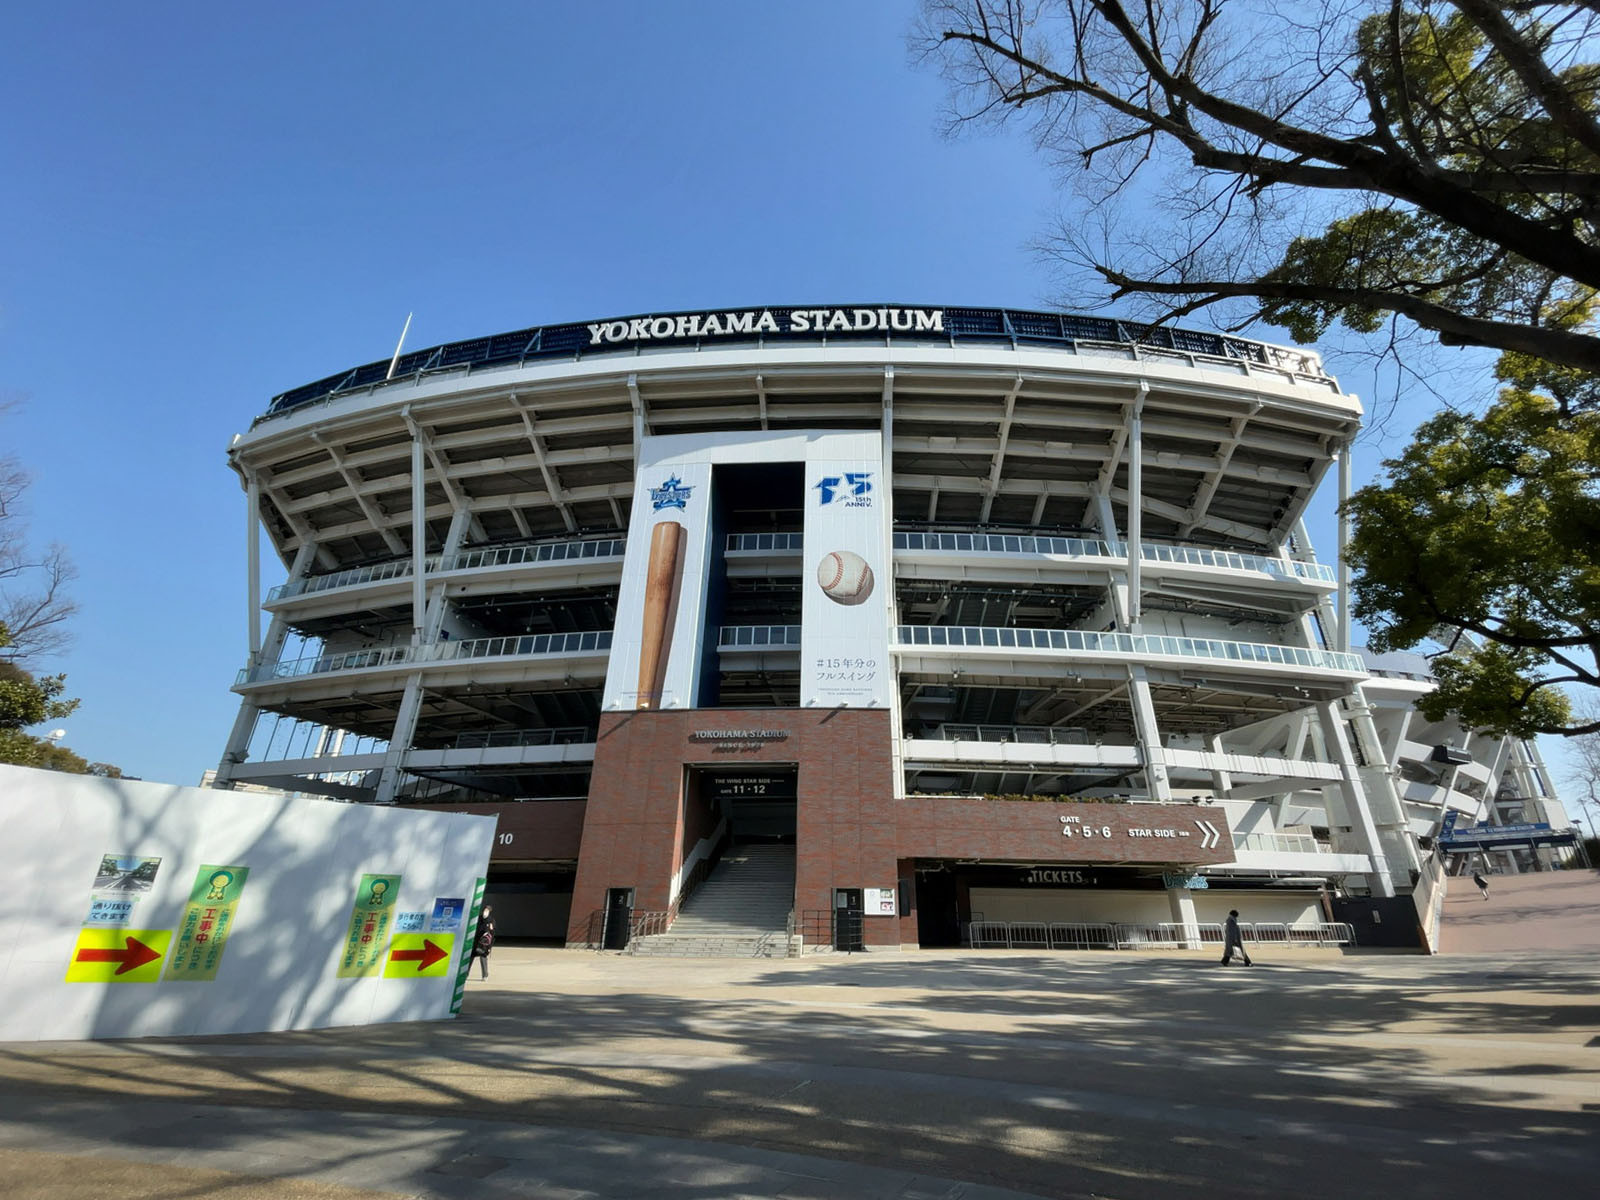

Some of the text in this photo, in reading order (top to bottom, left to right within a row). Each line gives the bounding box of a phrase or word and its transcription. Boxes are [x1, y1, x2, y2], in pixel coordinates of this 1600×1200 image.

[587, 309, 944, 344] YOKOHAMA STADIUM
[816, 671, 876, 681] フルスイング
[695, 729, 792, 738] YOKOHAMA STADIUM
[499, 833, 513, 845] 10
[1128, 829, 1153, 837] STAR
[1154, 830, 1176, 838] SIDE
[1031, 870, 1083, 883] TICKETS
